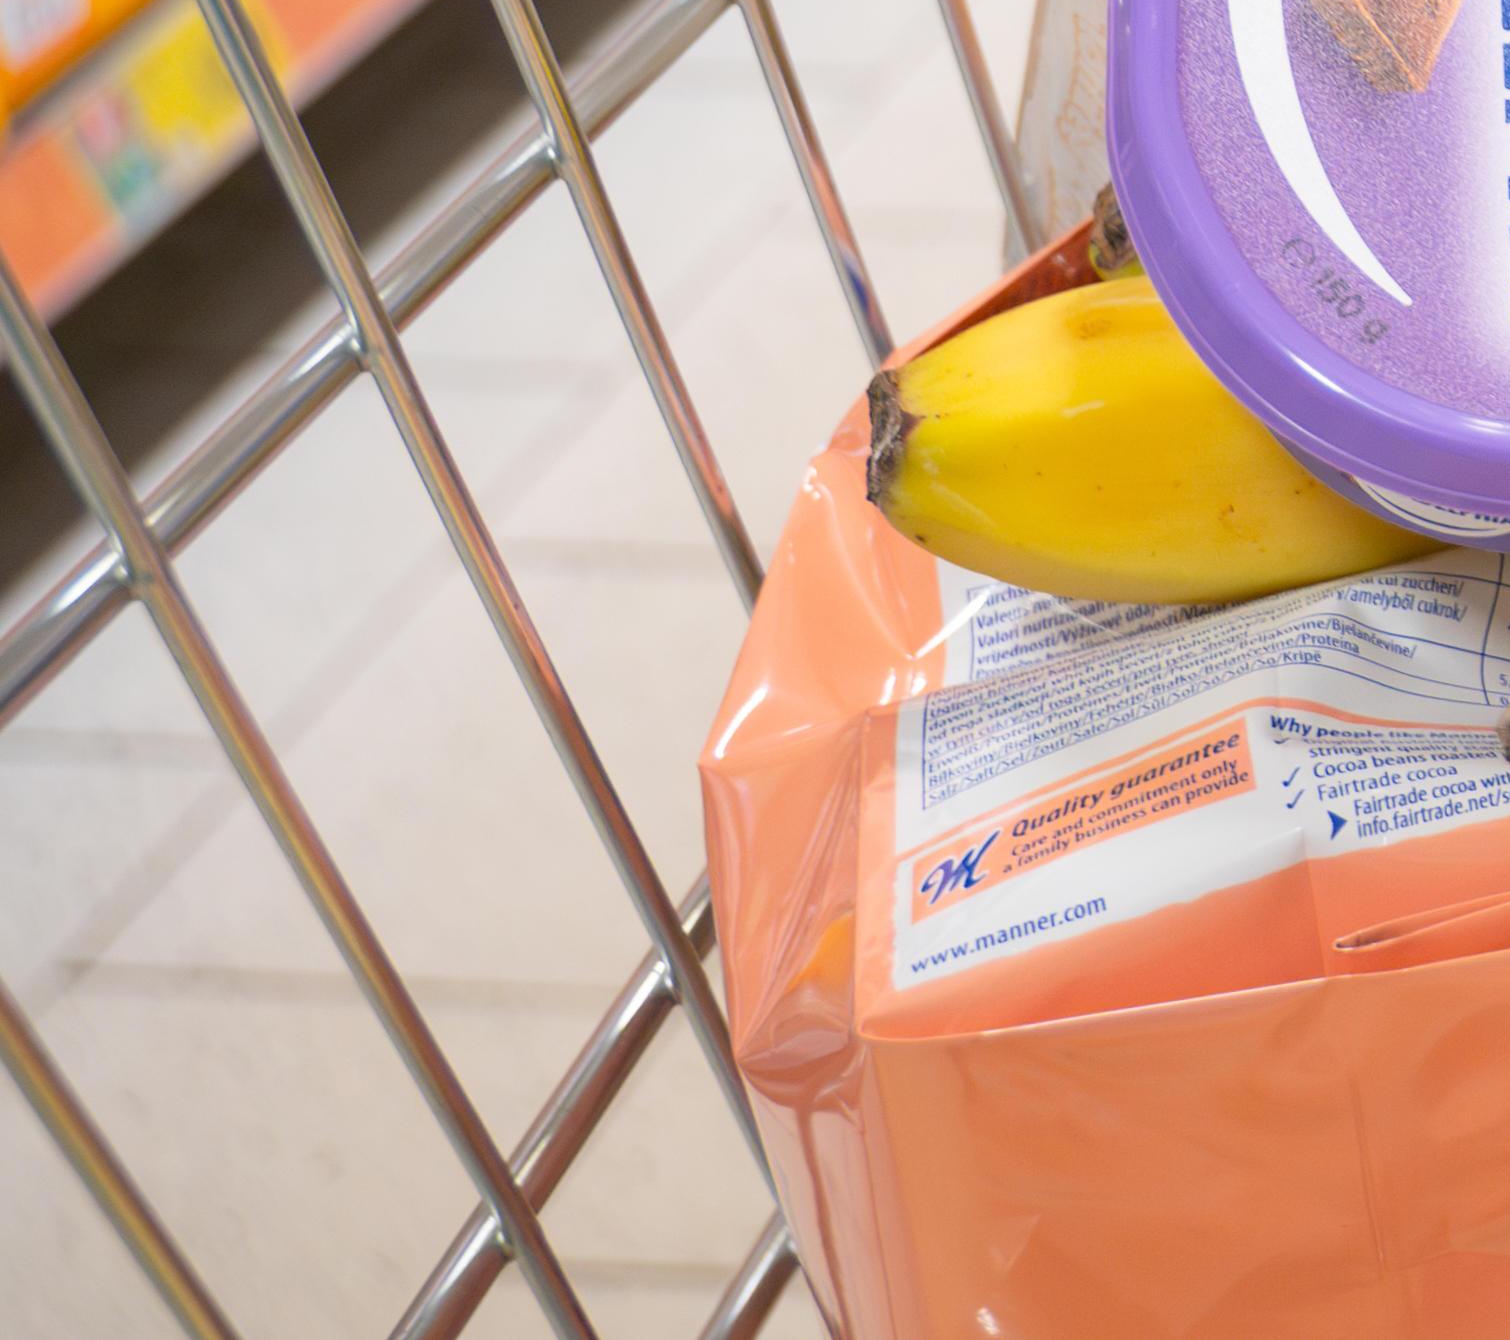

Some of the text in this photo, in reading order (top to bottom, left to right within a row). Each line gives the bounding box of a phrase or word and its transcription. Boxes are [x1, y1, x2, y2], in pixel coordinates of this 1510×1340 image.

[1270, 715, 1312, 736] Why
[1012, 733, 1240, 836] Quality guarantee
[1313, 759, 1368, 778] Cocoa
[1372, 754, 1426, 767] beans
[1317, 765, 1458, 800] Fairtrade cocoa
[1011, 760, 1237, 856] Care and commitment only
[1017, 840, 1070, 867] family
[1075, 809, 1147, 843] business
[1151, 795, 1181, 813] can
[1184, 771, 1248, 804] provide
[1353, 787, 1427, 816] Fairtrade
[1432, 778, 1477, 798] cocoa
[911, 897, 1107, 973] www.manner.com
